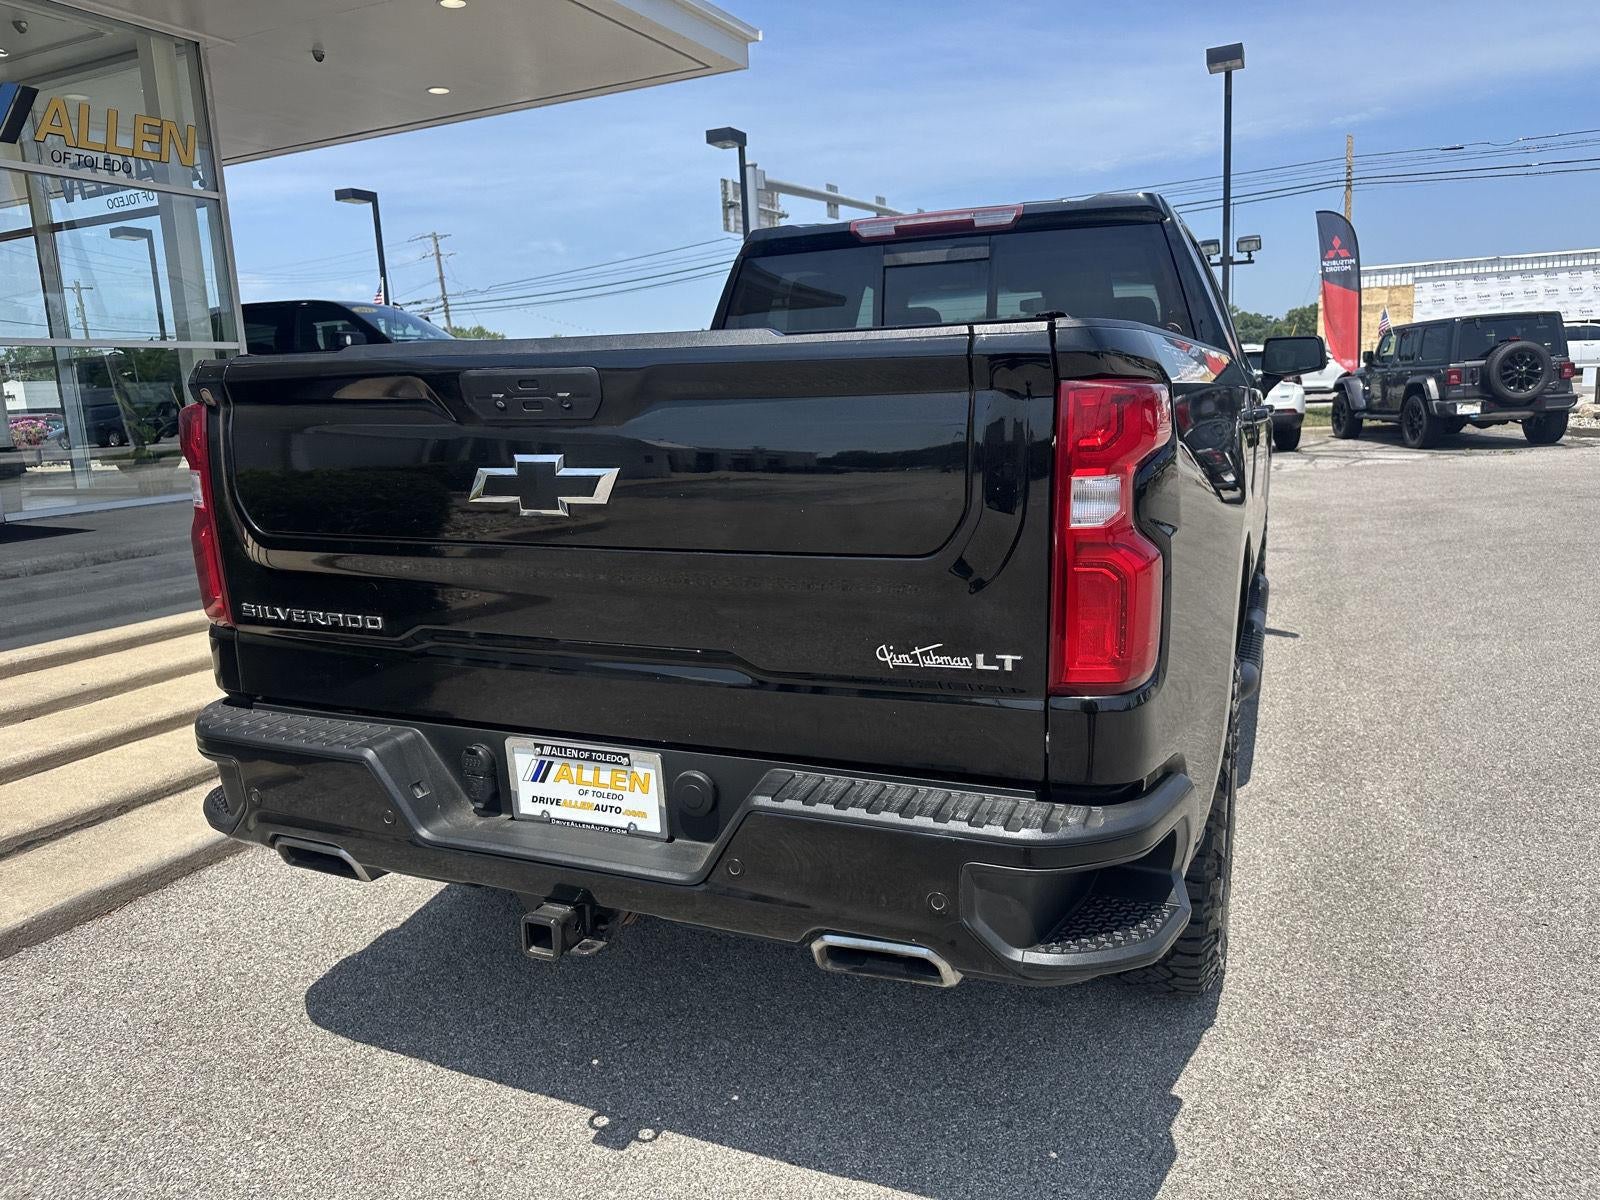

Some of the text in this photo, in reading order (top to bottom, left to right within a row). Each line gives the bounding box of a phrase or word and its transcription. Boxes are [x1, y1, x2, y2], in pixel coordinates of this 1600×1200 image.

[34, 96, 196, 168] ALLEN
[51, 149, 132, 174] OF TOLEDO
[240, 602, 385, 630] SILVERADO
[876, 643, 972, 669] Jim Tubman
[975, 653, 1024, 671] LT
[550, 746, 623, 763] ALLEN OF TOLEDO
[553, 762, 651, 795] ALLEN
[578, 788, 624, 801] OF TOLEDO
